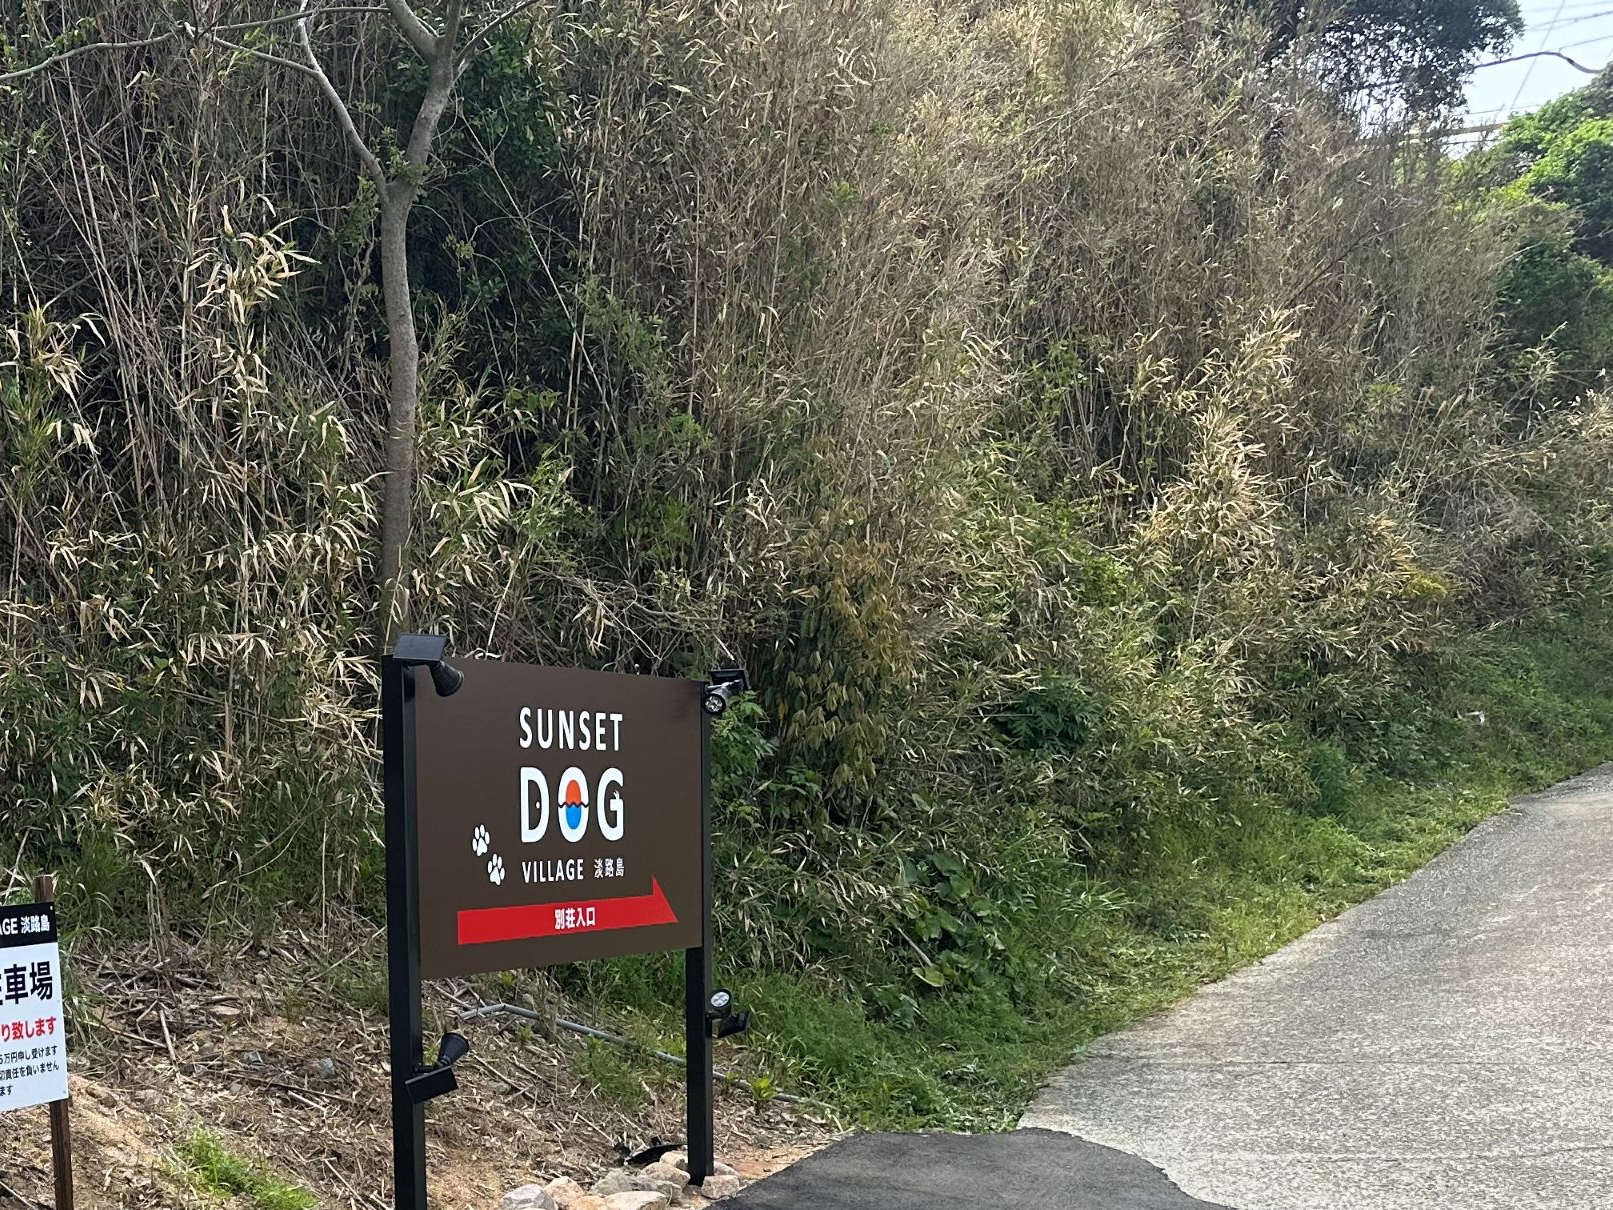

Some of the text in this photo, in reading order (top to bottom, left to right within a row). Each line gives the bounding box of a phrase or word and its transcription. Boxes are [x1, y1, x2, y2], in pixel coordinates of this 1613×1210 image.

[519, 706, 623, 751] SUNSET
[520, 766, 624, 843] DOG
[522, 857, 625, 883] VILLAGE 淡路島
[20, 914, 51, 934] 淡路島
[554, 906, 596, 930] 別荘入口
